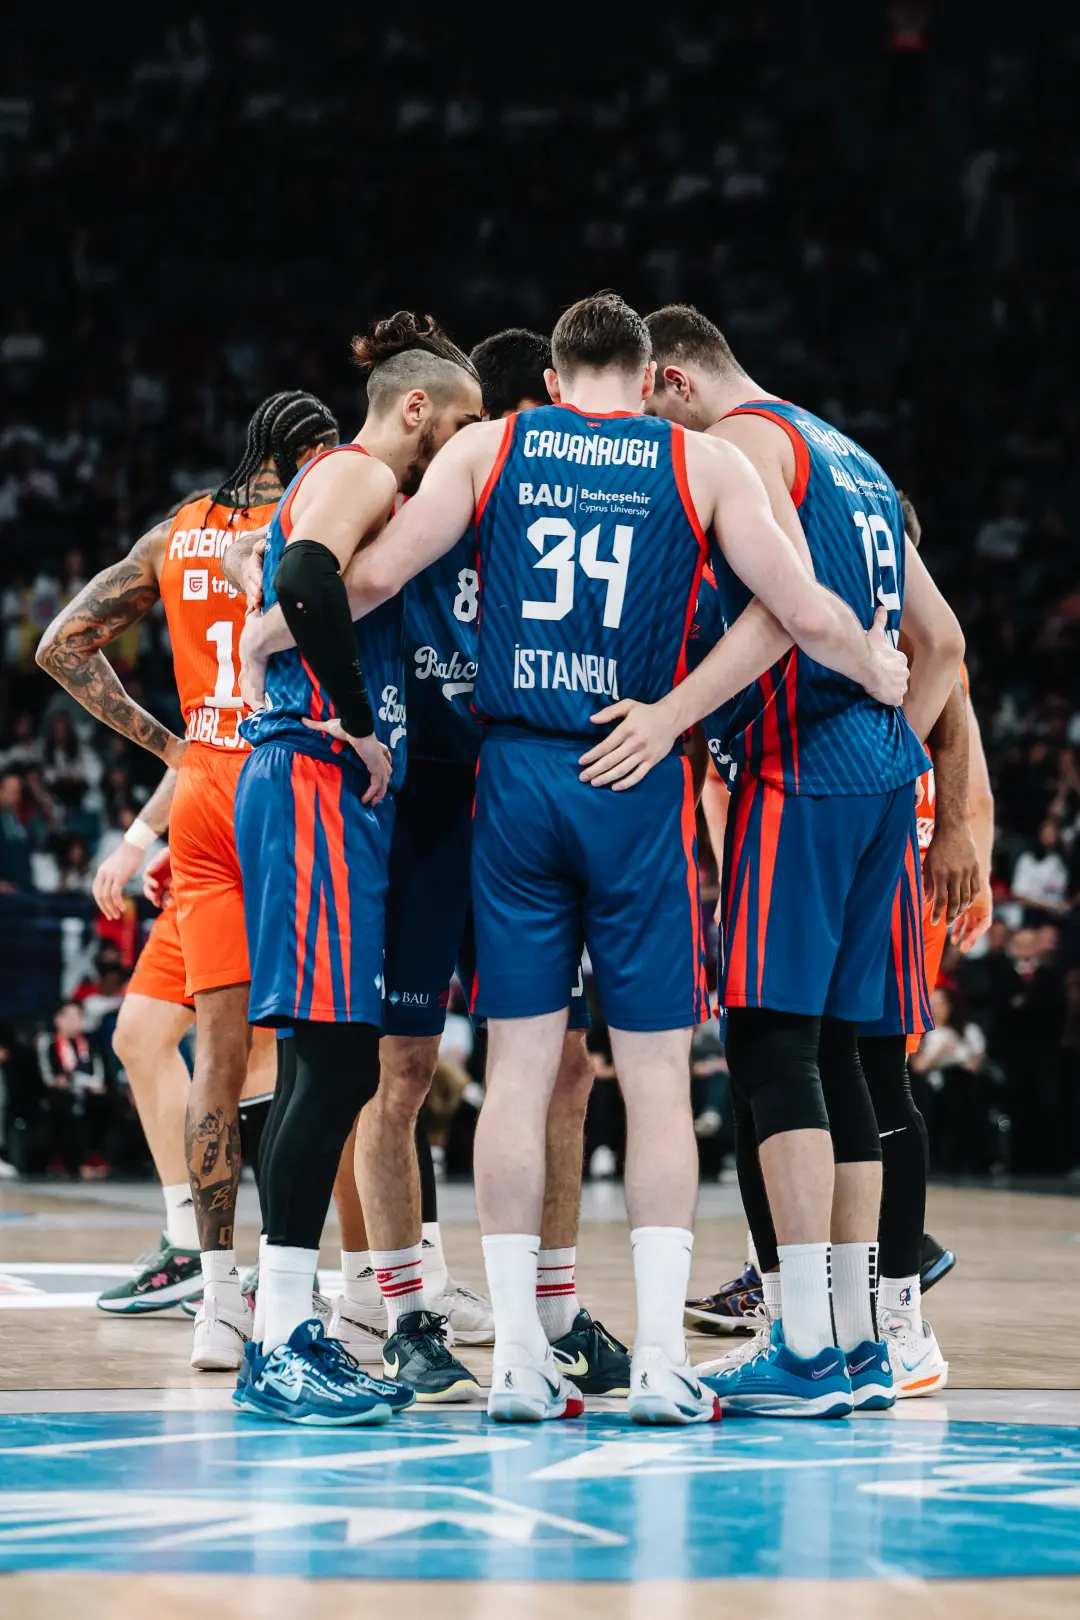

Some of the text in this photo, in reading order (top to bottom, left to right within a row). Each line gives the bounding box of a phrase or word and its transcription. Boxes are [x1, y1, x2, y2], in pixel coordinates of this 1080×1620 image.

[524, 429, 660, 469] CAVANAUGH
[518, 482, 573, 508] BAU
[579, 502, 650, 518] Cyprus University
[580, 488, 651, 505] Bahçeşehir
[521, 516, 634, 629] 34
[853, 510, 901, 611] 19
[211, 576, 241, 599] trig
[204, 620, 244, 708] 1
[185, 707, 254, 749] JUBLJ
[402, 991, 430, 1005] BAU
